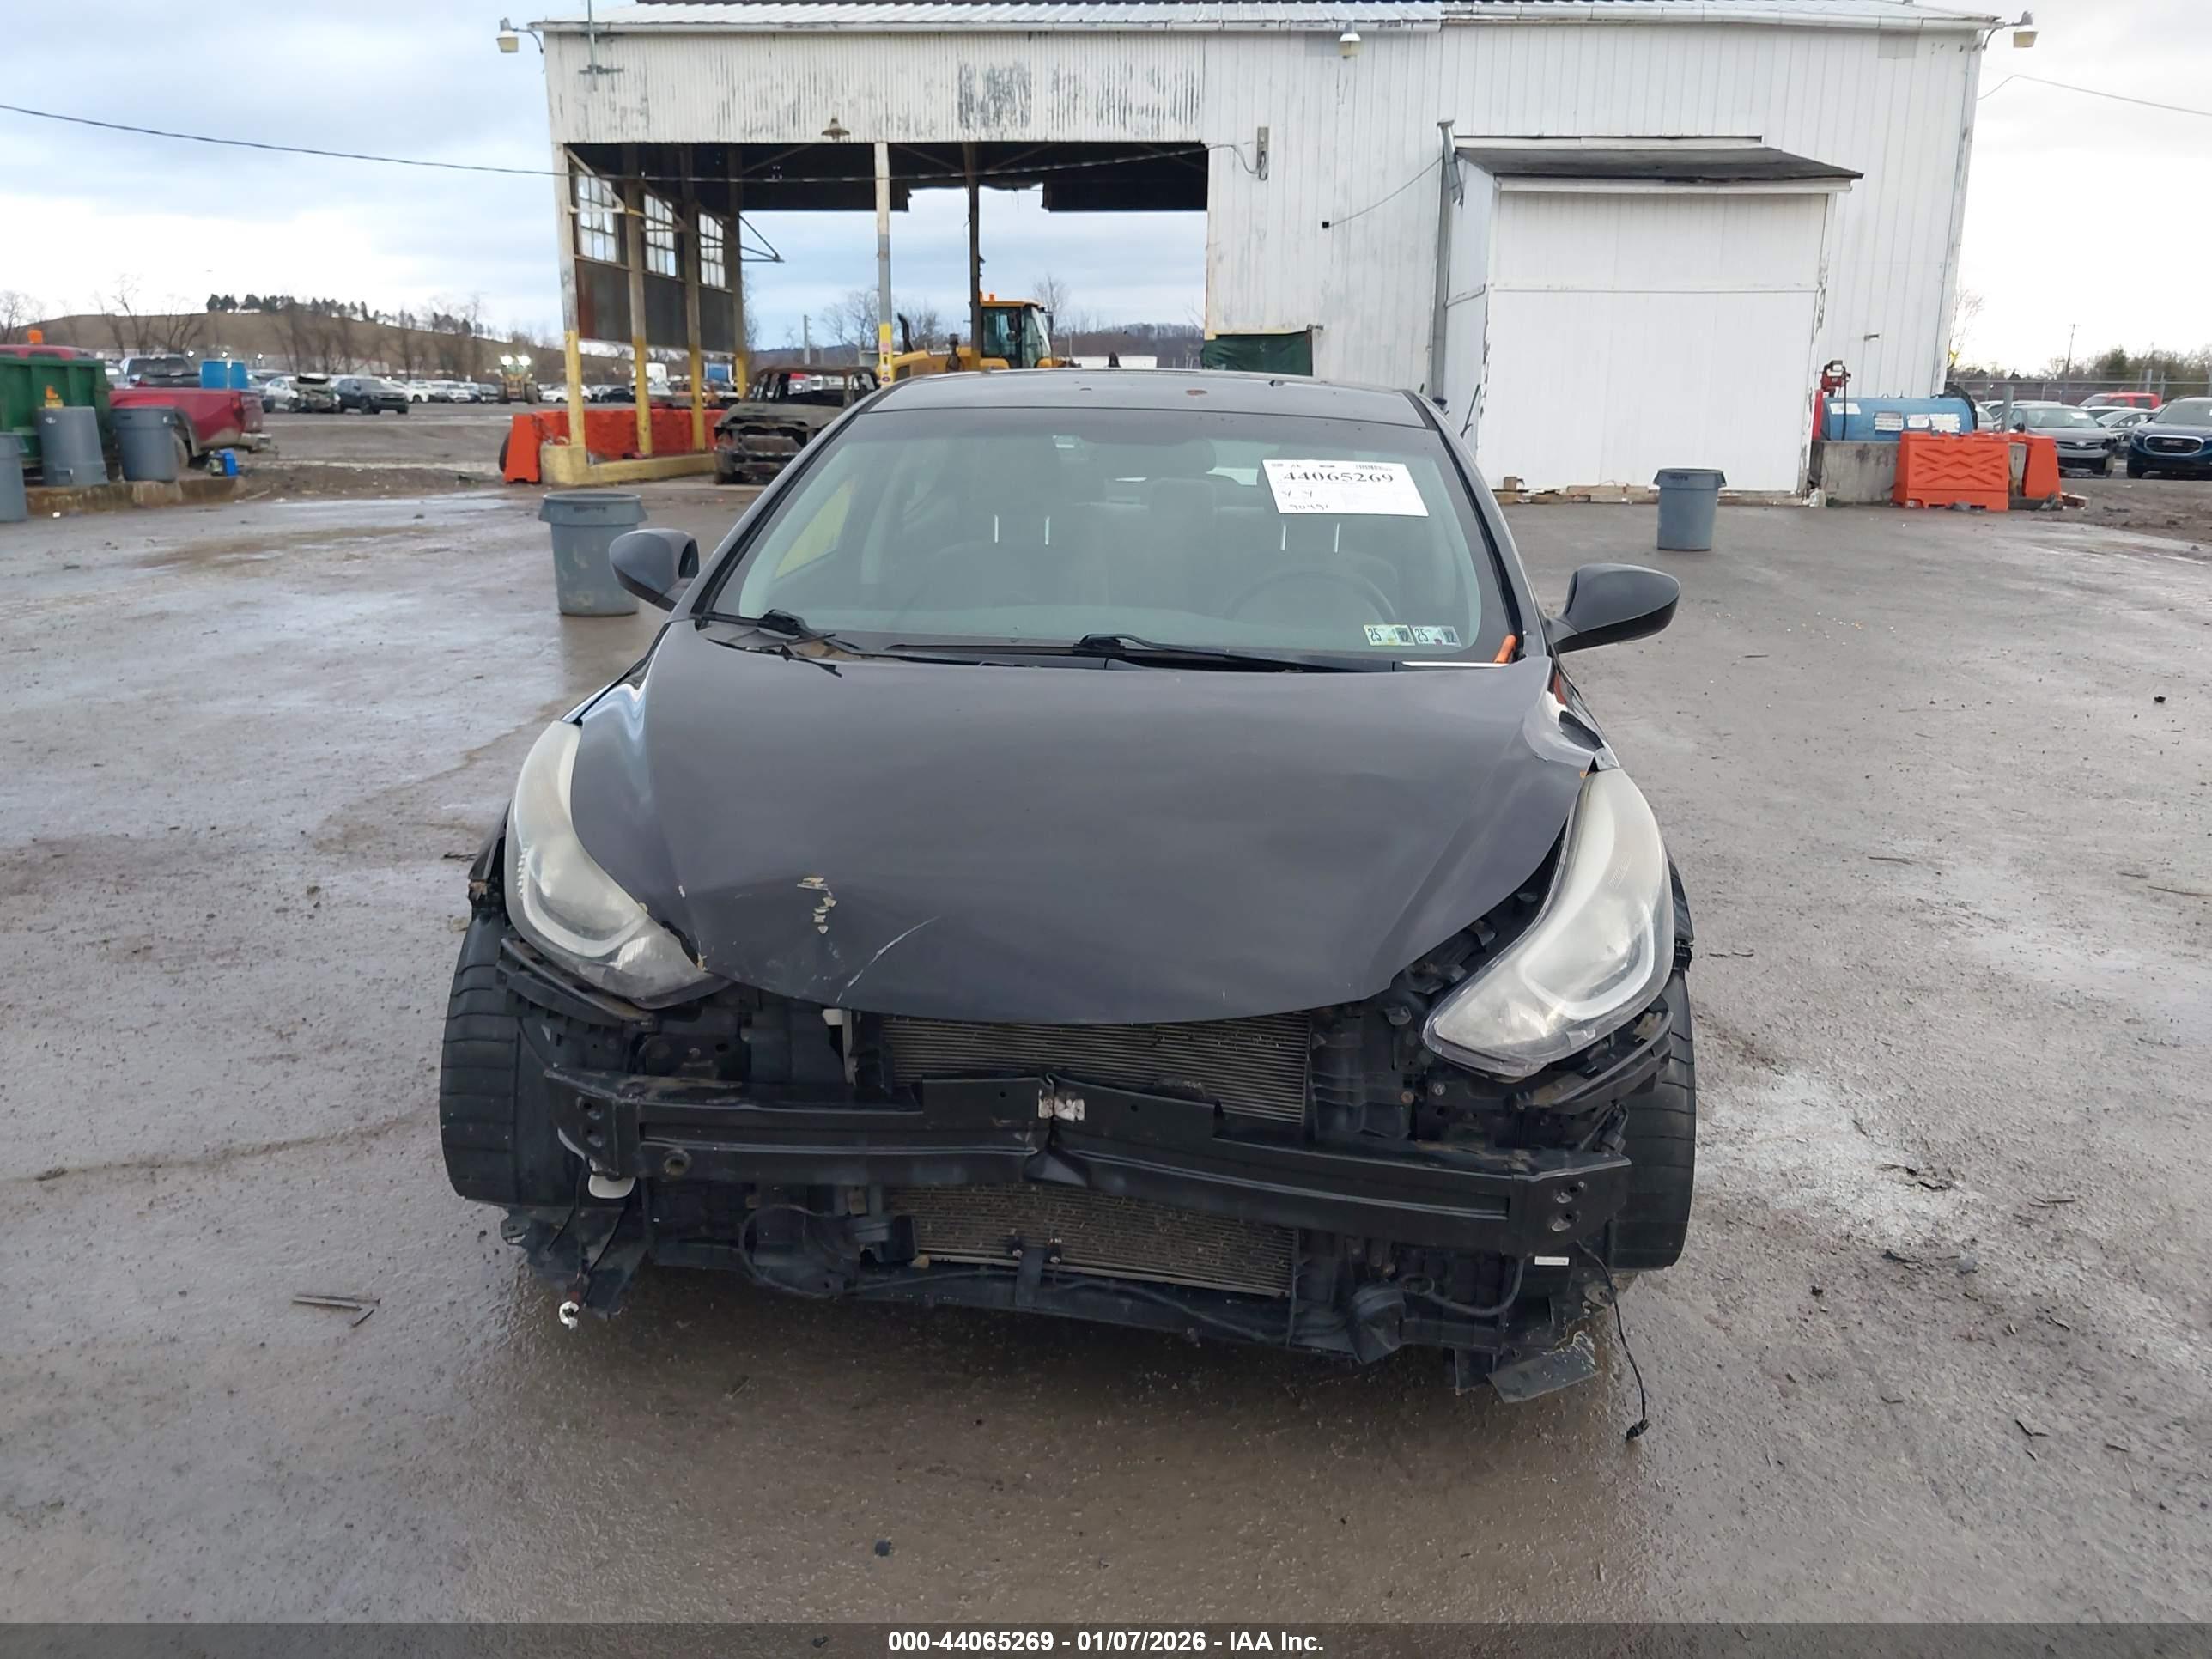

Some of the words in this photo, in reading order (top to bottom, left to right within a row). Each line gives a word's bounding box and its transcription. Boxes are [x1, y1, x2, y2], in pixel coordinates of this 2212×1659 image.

[1284, 471, 1394, 483] 44065269
[1368, 627, 1382, 642] 25
[1414, 628, 1429, 642] 25
